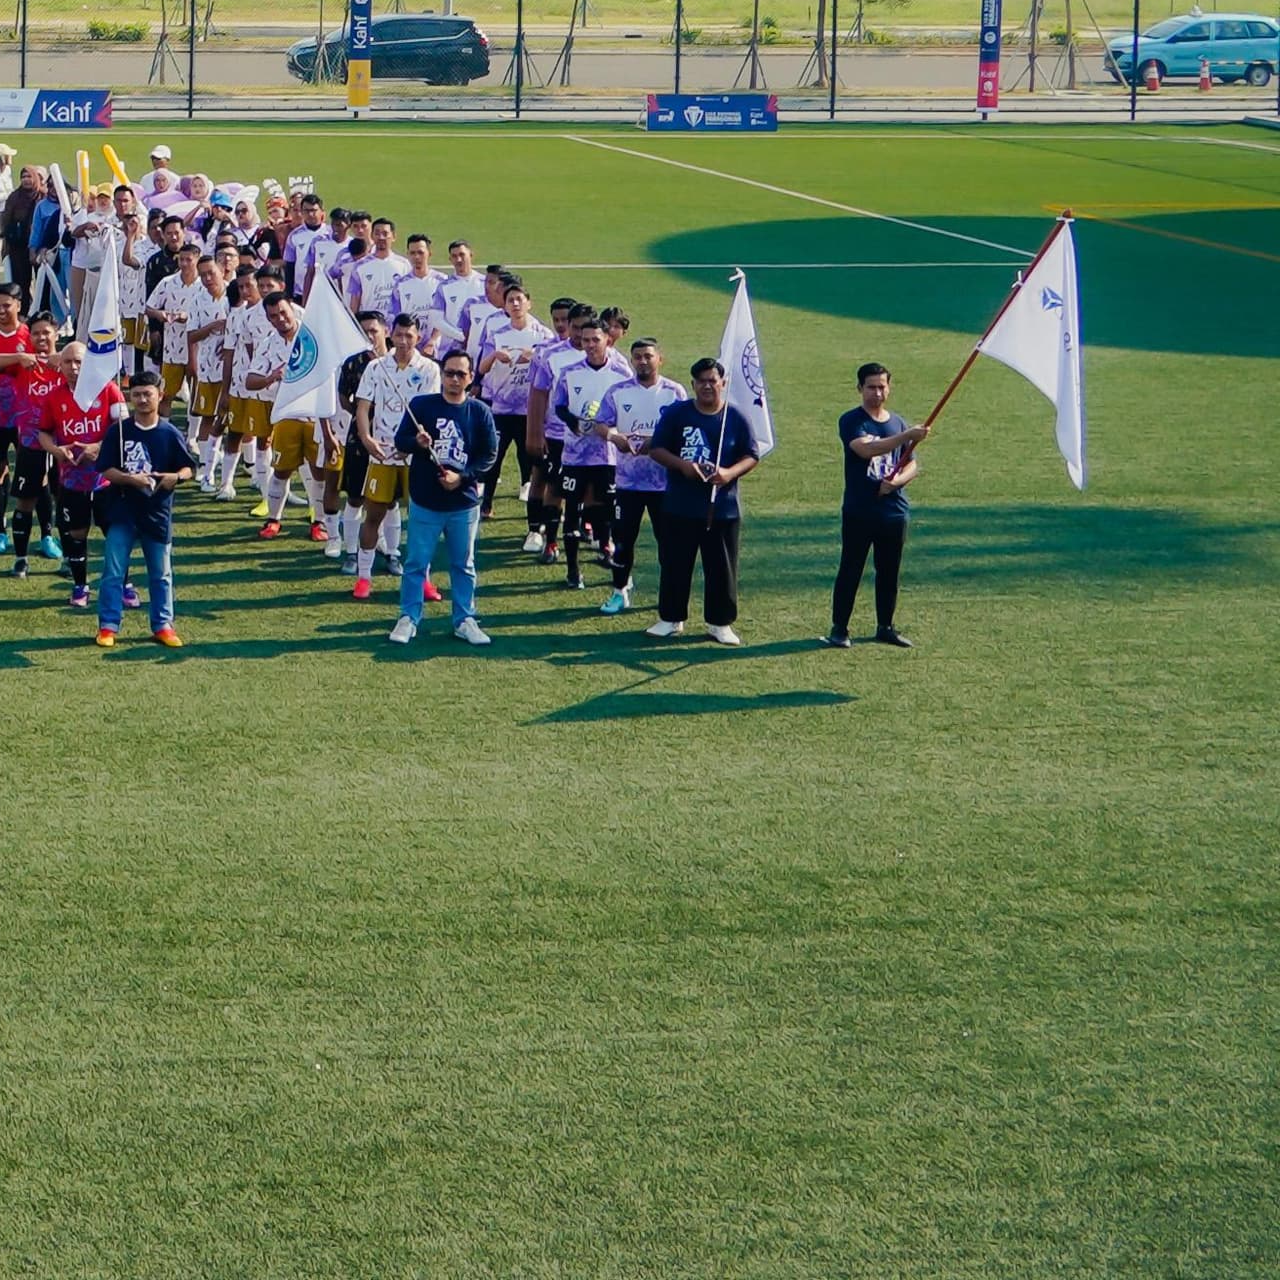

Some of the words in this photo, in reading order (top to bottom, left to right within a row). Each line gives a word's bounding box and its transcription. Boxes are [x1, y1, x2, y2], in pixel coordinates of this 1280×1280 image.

[352, 15, 368, 49] Kahf
[42, 101, 92, 122] Kahf
[62, 415, 102, 437] Kahf
[18, 476, 26, 491] 7
[562, 476, 577, 491] 20
